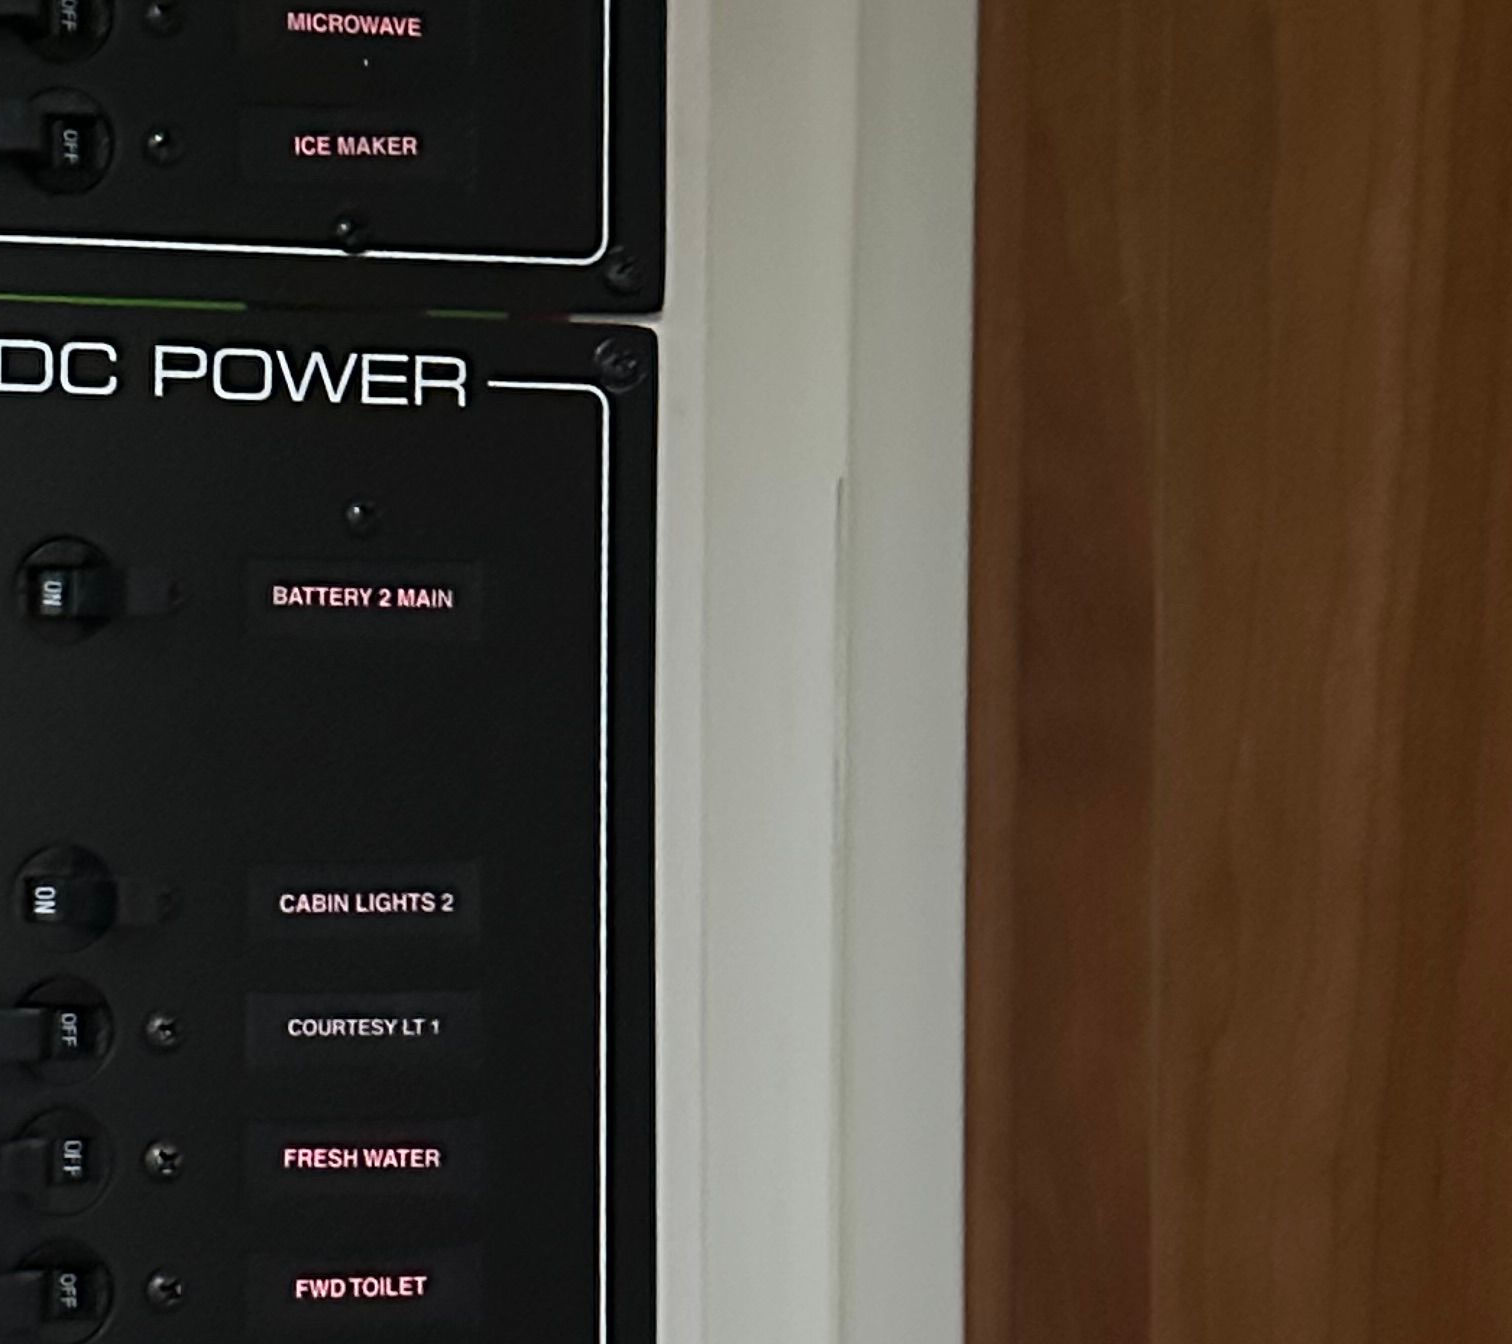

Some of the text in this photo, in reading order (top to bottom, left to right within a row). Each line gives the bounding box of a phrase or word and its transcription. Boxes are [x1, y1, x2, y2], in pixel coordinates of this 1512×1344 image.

[287, 11, 422, 37] MICROWAVE
[62, 129, 80, 165] OFF
[294, 135, 418, 156] ICE MAKER
[154, 344, 467, 408] POWER
[272, 585, 453, 609] BATTERY 2 MAIN
[33, 886, 56, 914] ON
[279, 892, 454, 914] CABIN LIGHTS 2
[61, 1012, 78, 1047] OFF
[287, 1018, 440, 1037] COURTESY LT 1
[63, 1140, 83, 1176] OFF
[283, 1147, 441, 1169] FRESH WATER
[59, 1273, 78, 1308] OFF
[295, 1275, 428, 1299] FWD TOILET
